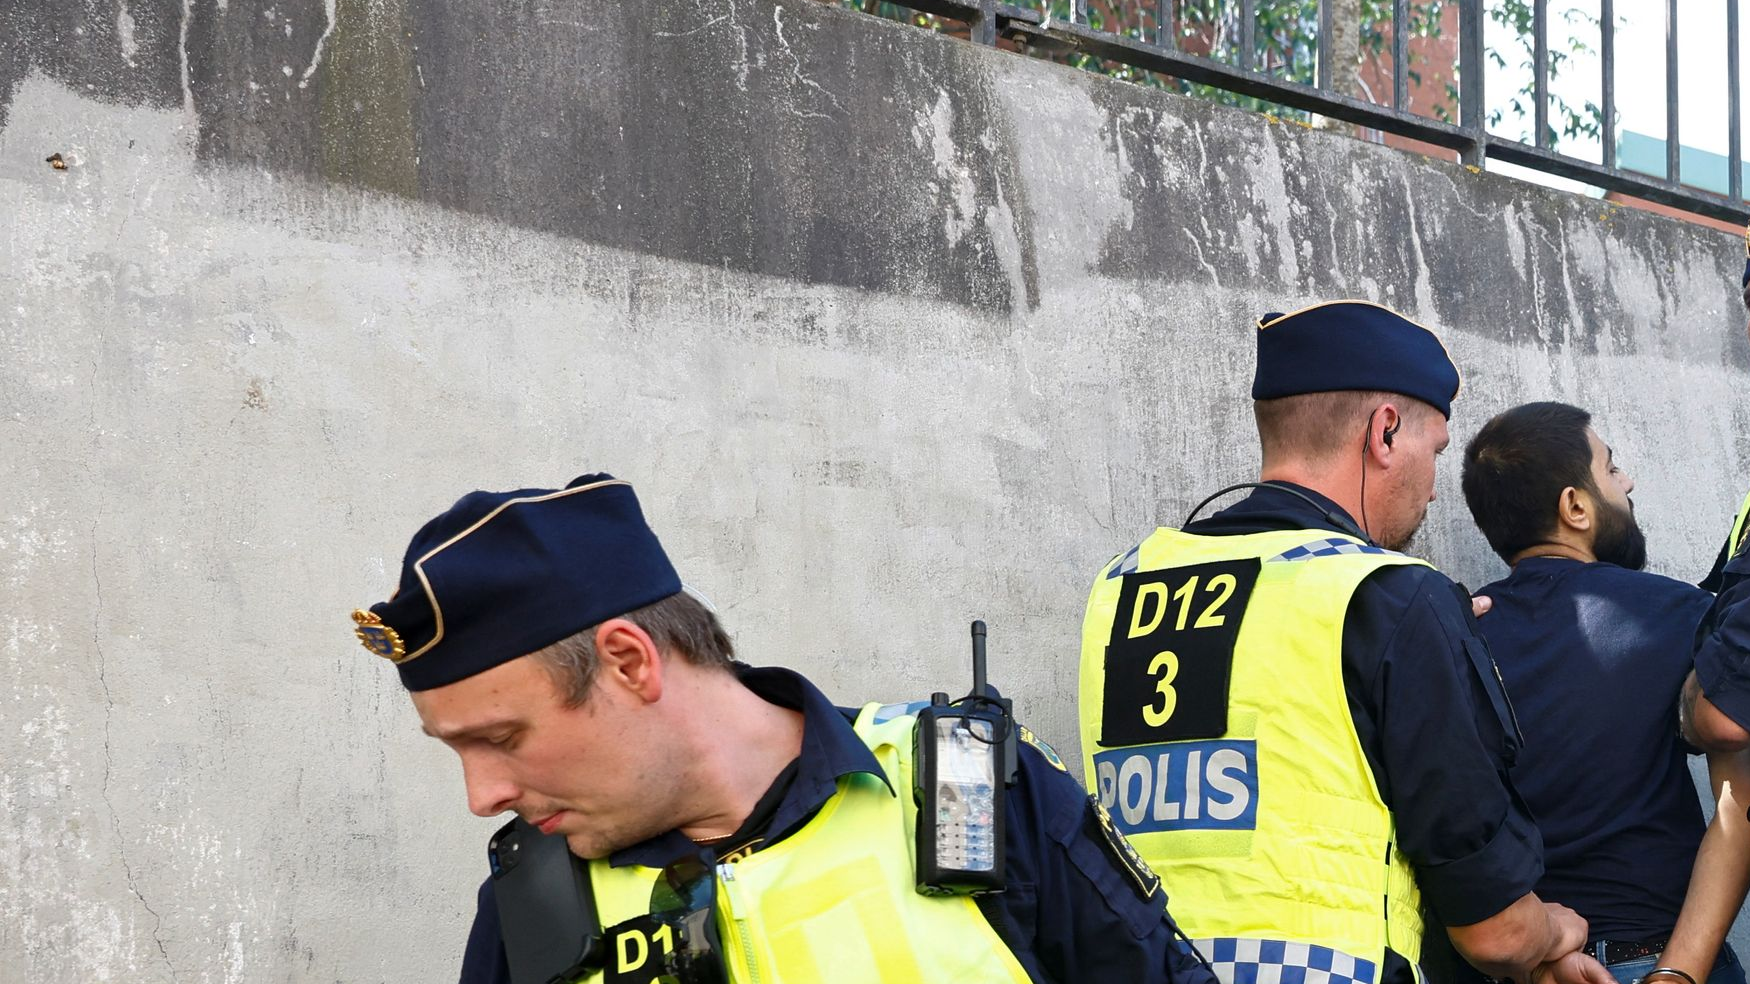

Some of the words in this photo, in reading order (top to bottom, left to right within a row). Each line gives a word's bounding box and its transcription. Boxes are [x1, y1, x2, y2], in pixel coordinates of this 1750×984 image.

[1127, 573, 1238, 640] D12
[1141, 650, 1180, 728] 3
[1096, 749, 1251, 826] POLIS
[617, 923, 683, 974] D1
